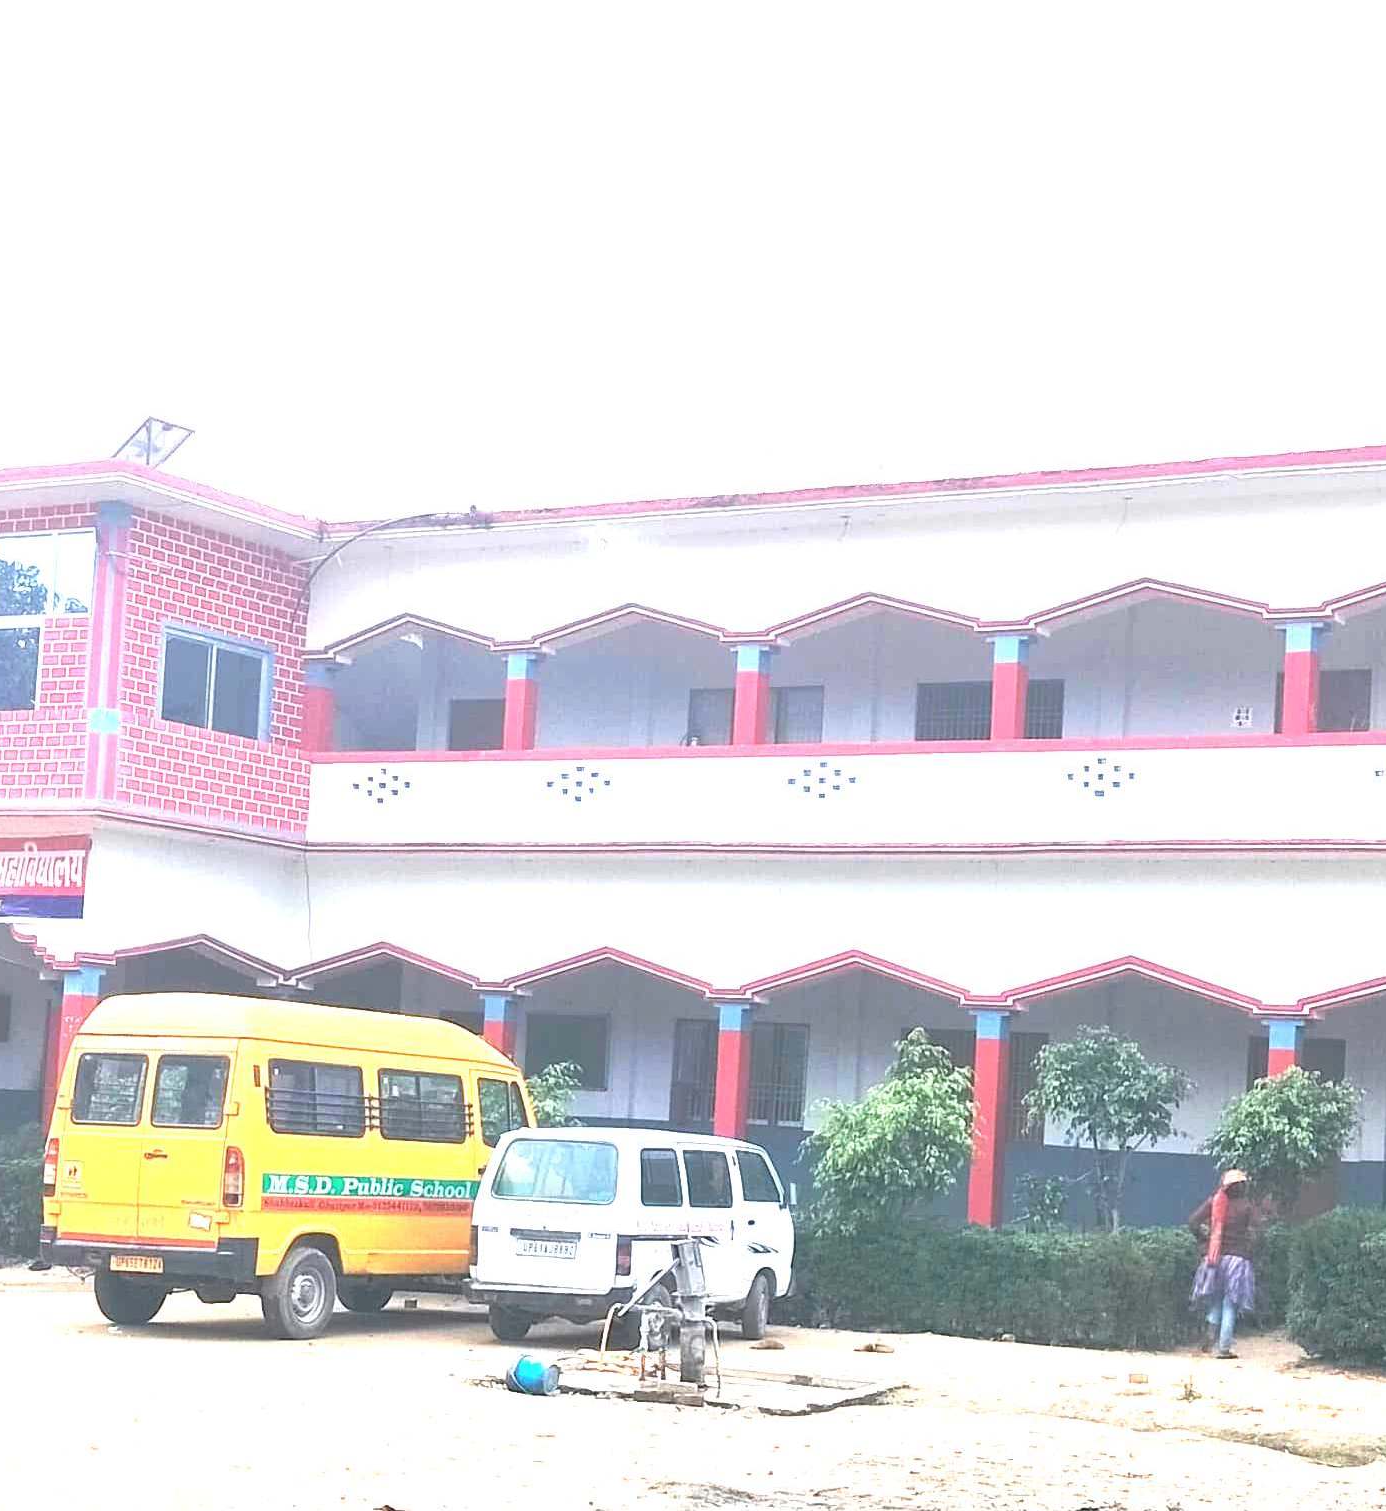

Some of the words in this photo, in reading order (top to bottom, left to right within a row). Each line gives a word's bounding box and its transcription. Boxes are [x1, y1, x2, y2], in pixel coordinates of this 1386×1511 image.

[267, 1175, 335, 1196] M.S.D.
[341, 1177, 404, 1197] Public
[409, 1180, 472, 1199] School
